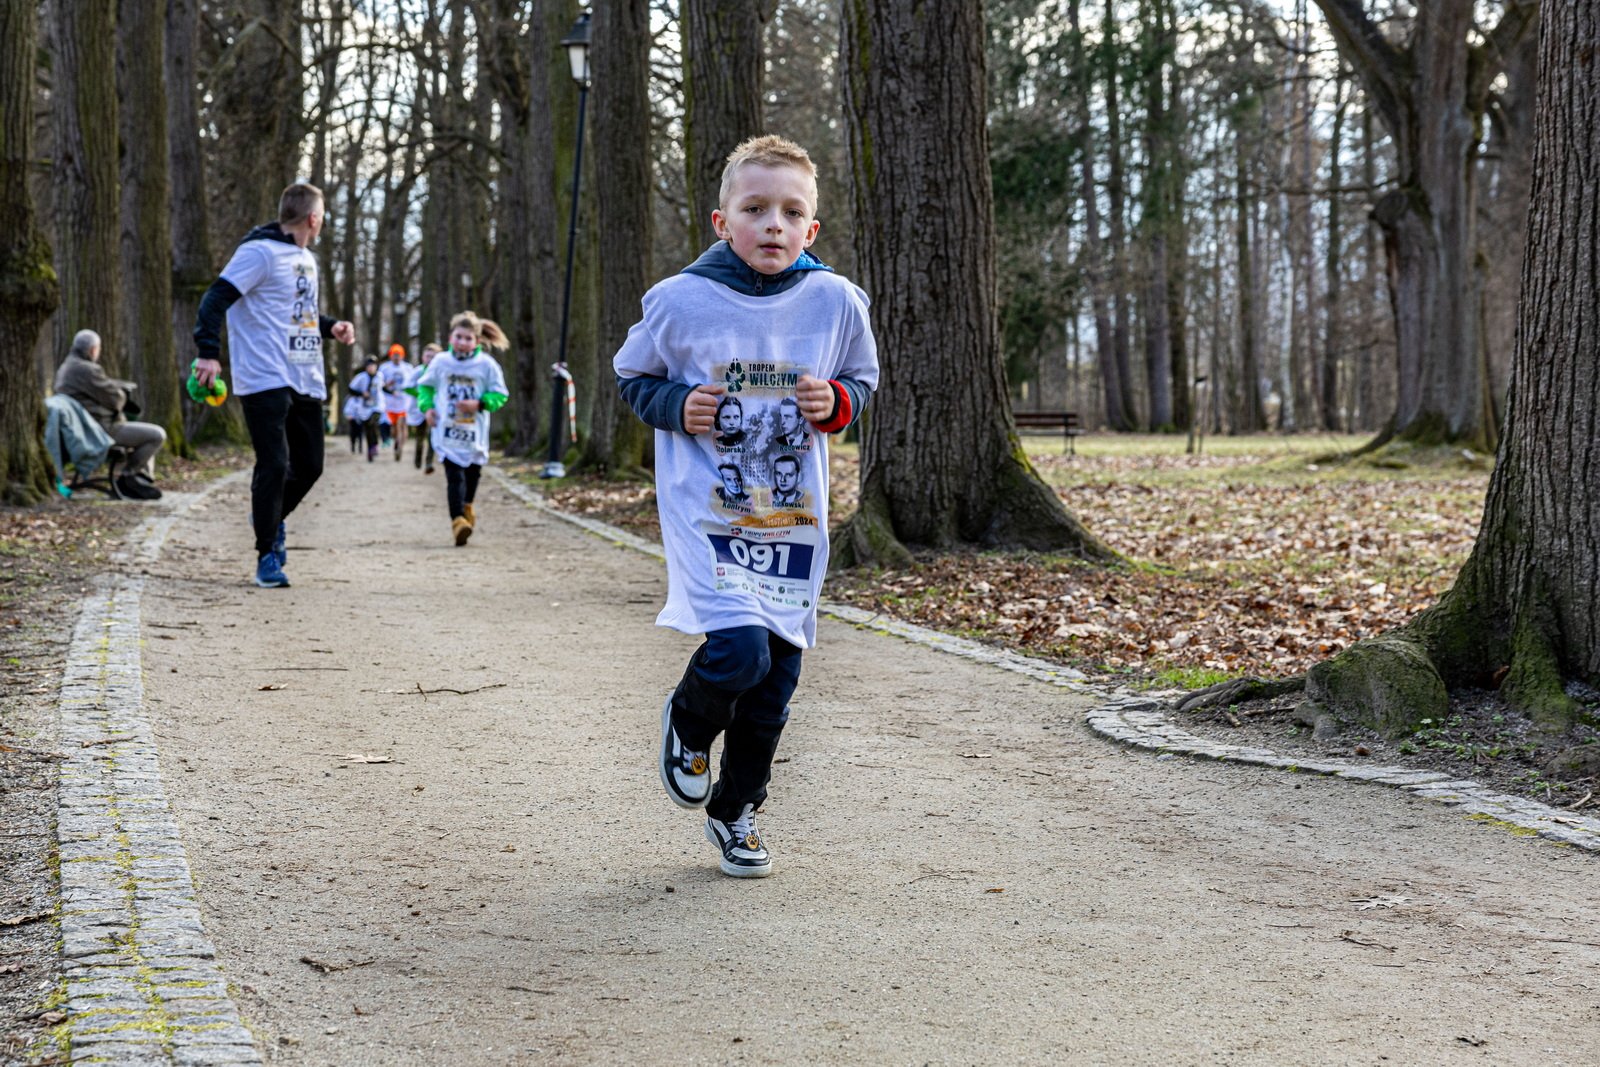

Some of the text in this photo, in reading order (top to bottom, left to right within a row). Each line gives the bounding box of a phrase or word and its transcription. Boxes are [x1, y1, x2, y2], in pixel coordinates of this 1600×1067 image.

[748, 363, 776, 372] TROPEM
[749, 373, 798, 386] WILCZYM
[728, 538, 791, 576] 091
